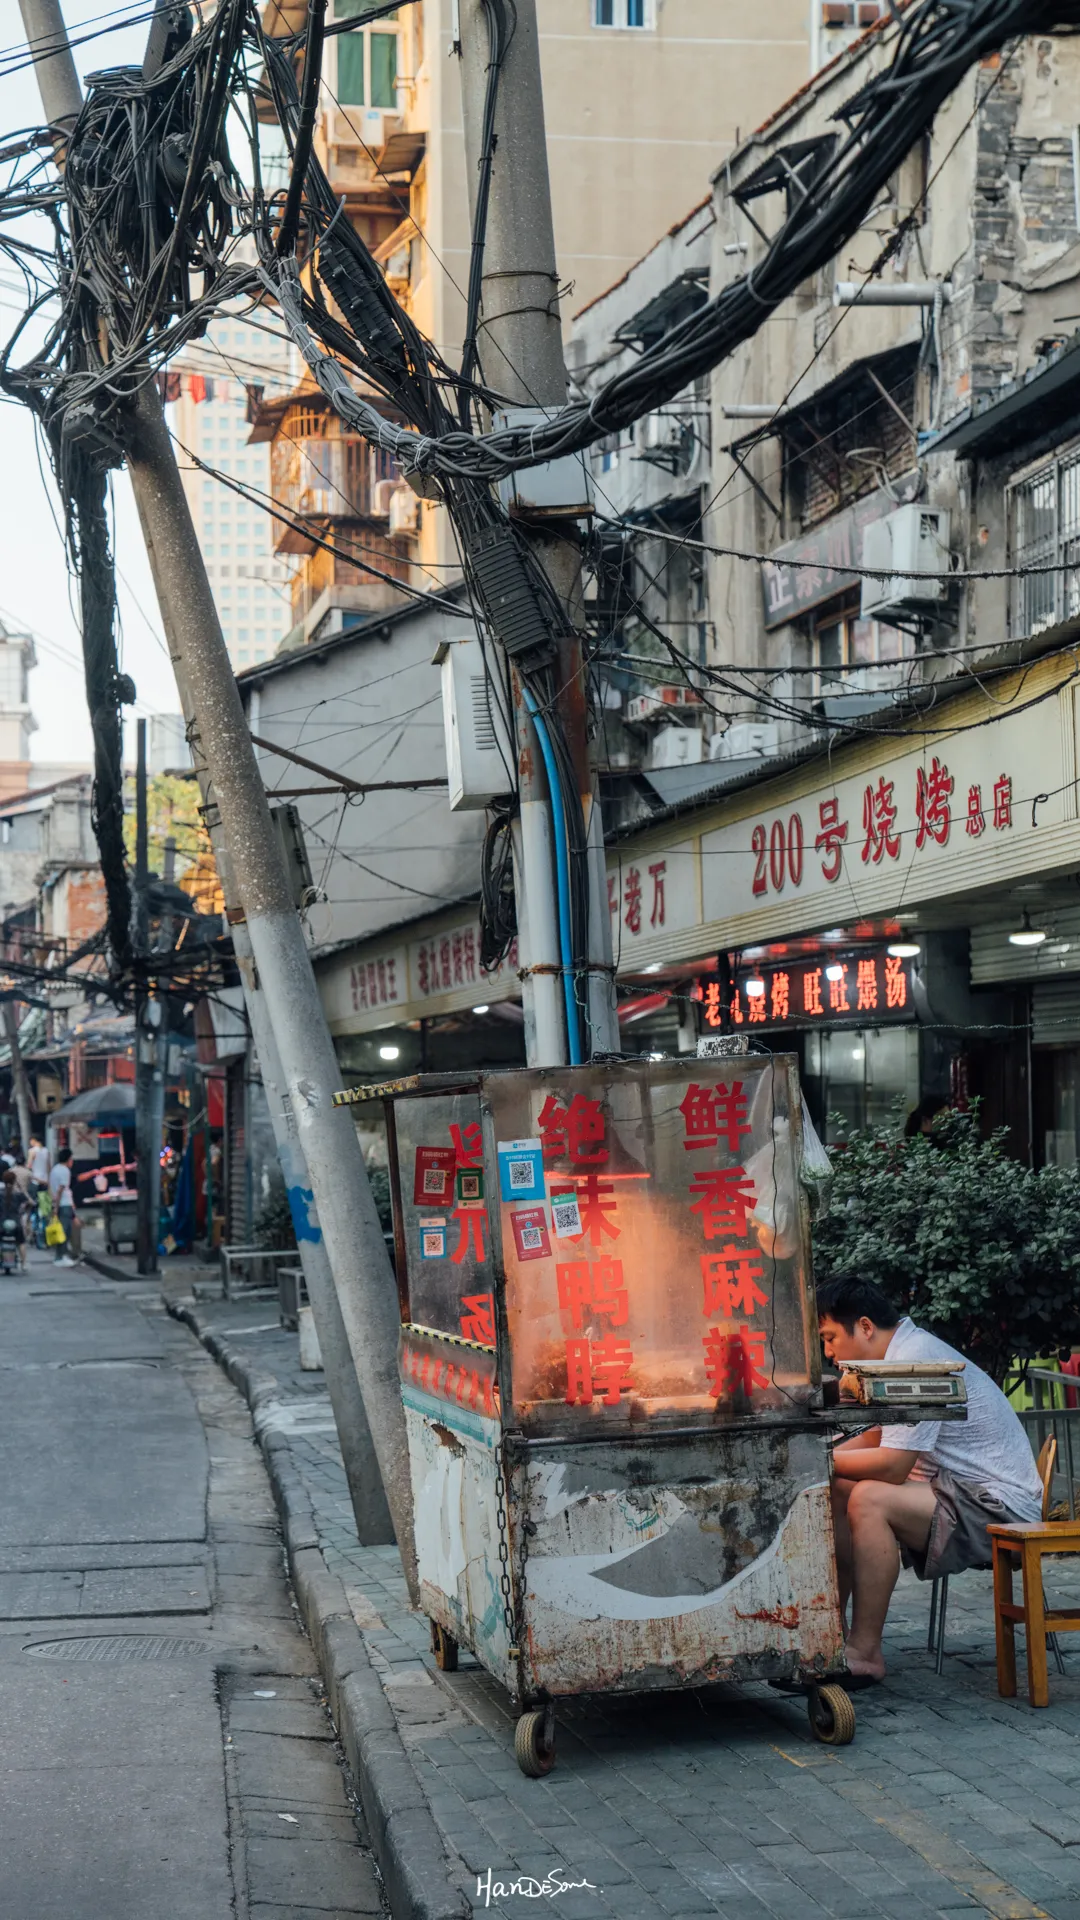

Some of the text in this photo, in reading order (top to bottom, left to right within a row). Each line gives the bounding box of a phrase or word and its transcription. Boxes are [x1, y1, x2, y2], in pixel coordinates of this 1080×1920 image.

[537, 1093, 636, 1407] 绝味鸭脖
[679, 1080, 771, 1399] 鲜香麻辣
